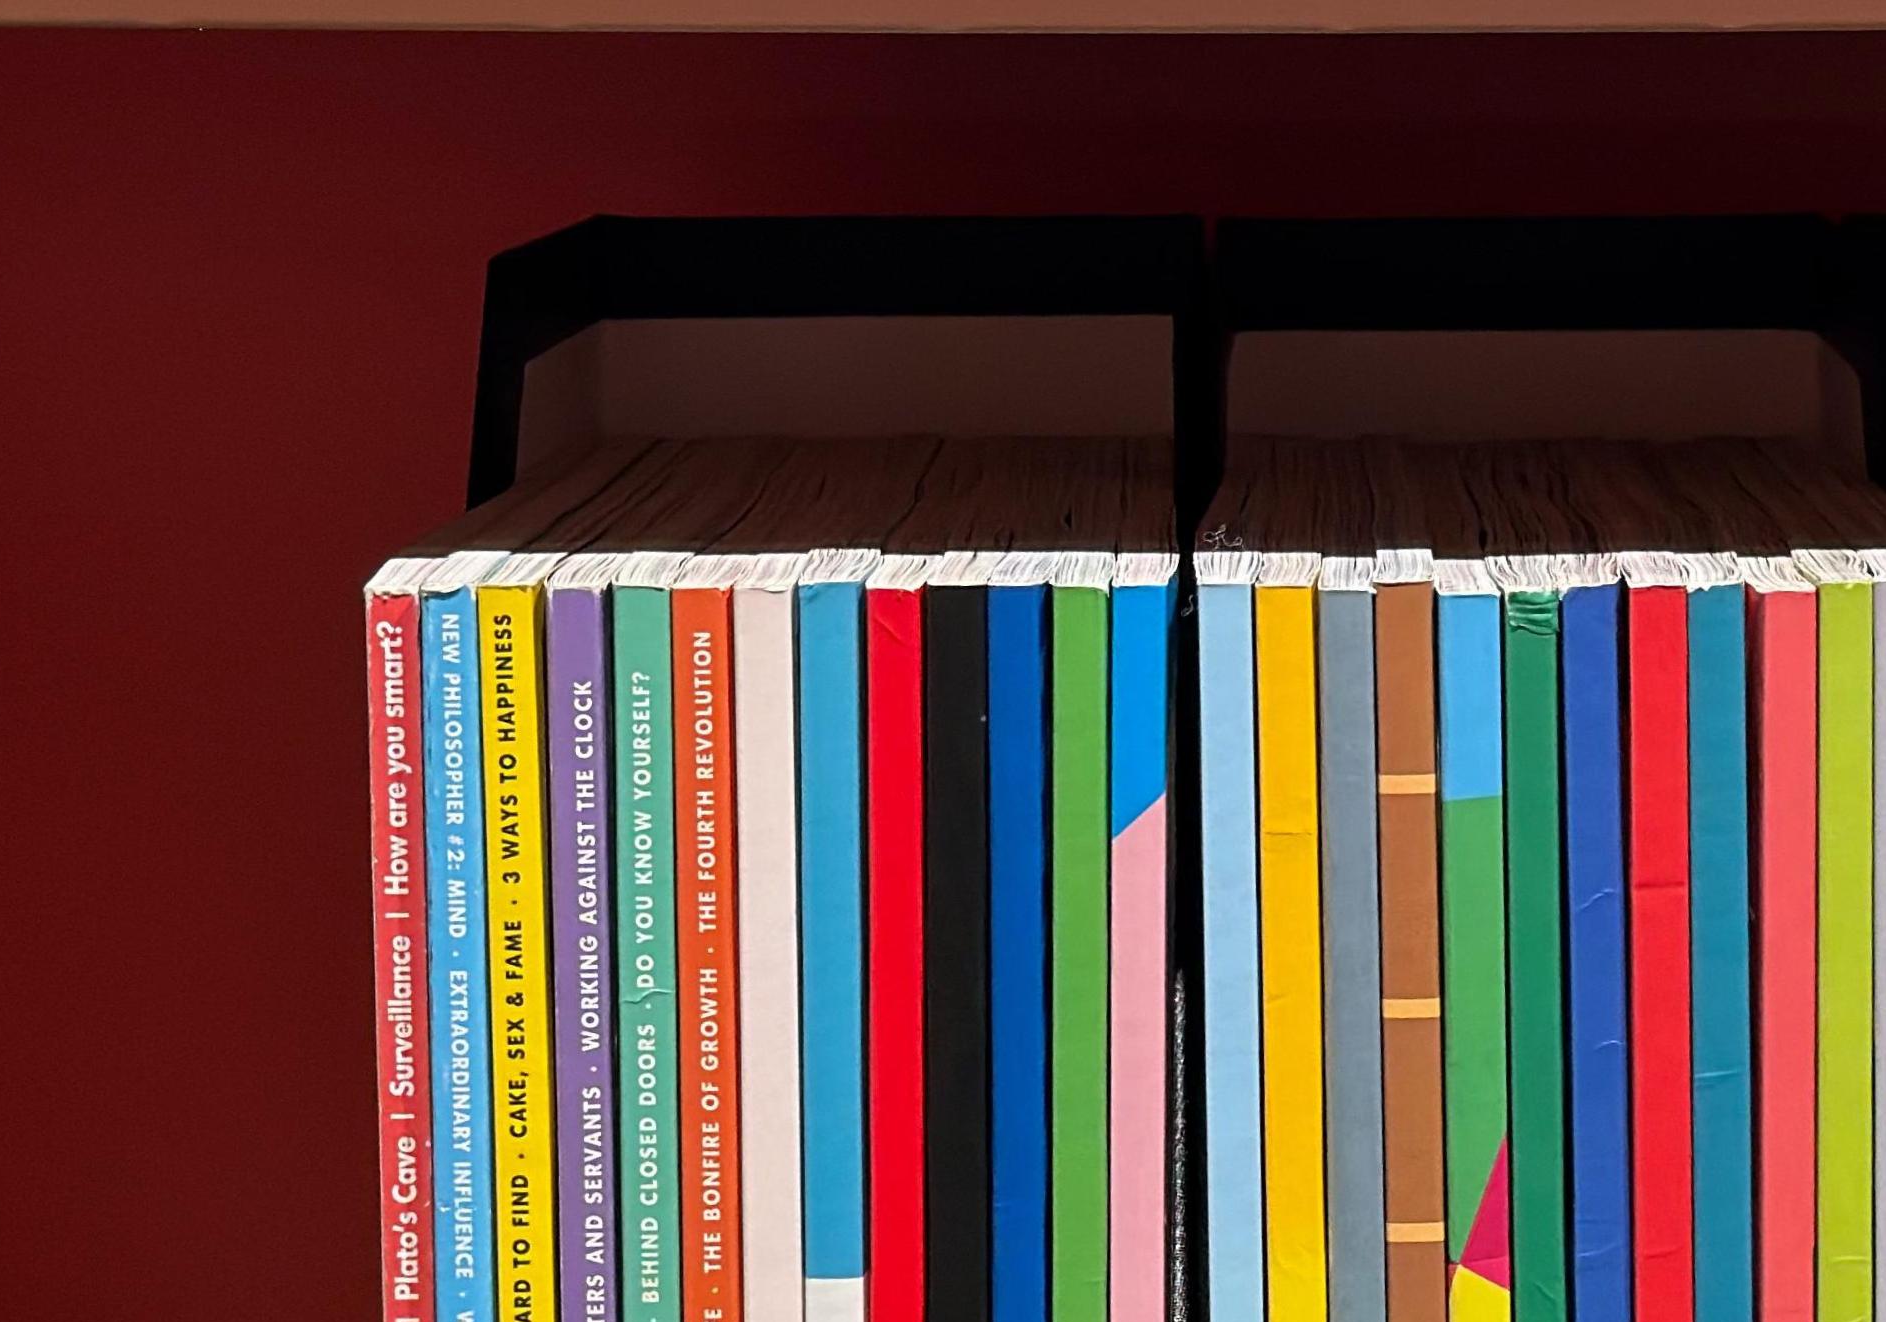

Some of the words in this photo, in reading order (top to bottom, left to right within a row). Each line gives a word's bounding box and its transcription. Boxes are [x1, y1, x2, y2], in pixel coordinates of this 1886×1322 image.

[376, 621, 404, 717] smart?
[442, 614, 460, 663] NEW
[494, 615, 515, 741] HAPPINESS
[693, 631, 713, 779] REVOLUTION
[387, 726, 412, 775] you
[444, 673, 464, 824] PHILOSOPHER
[574, 682, 593, 758] CLOCK
[632, 672, 651, 800] YOURSELF?
[499, 754, 517, 783] TO
[576, 770, 594, 811] THE
[388, 783, 407, 827] are
[500, 795, 519, 859] WAYS
[696, 791, 715, 880] FOURTH
[384, 835, 409, 894] How
[447, 836, 465, 869] #2:
[503, 872, 520, 883] 3
[577, 822, 597, 924] AGAINST
[633, 811, 652, 884] KNOW
[448, 880, 466, 938] MIND
[636, 896, 653, 943] YOU
[698, 892, 716, 932] THE
[505, 922, 523, 979] FAME
[636, 955, 654, 987] DO
[387, 936, 414, 1096] Surveillance
[506, 993, 523, 1006] &
[579, 936, 599, 1051] WORKING
[699, 969, 718, 1071] GROWTH
[450, 971, 471, 1151] EXTRAORDINARY
[507, 1019, 525, 1059] SEX
[637, 1025, 656, 1105] DOORS
[509, 1072, 528, 1137] CAKE,
[701, 1083, 719, 1111] OF
[391, 1137, 417, 1204] Cave
[582, 1087, 602, 1203] SERVANTS
[639, 1118, 658, 1205] CLOSED
[702, 1123, 721, 1220] BONFIRE
[454, 1161, 473, 1278] INFLUENCE
[512, 1175, 529, 1226] FIND
[393, 1212, 418, 1300] Plato's
[513, 1239, 530, 1268] TO
[585, 1216, 604, 1263] AND
[641, 1217, 659, 1302] BEHIND
[703, 1233, 721, 1272] THE
